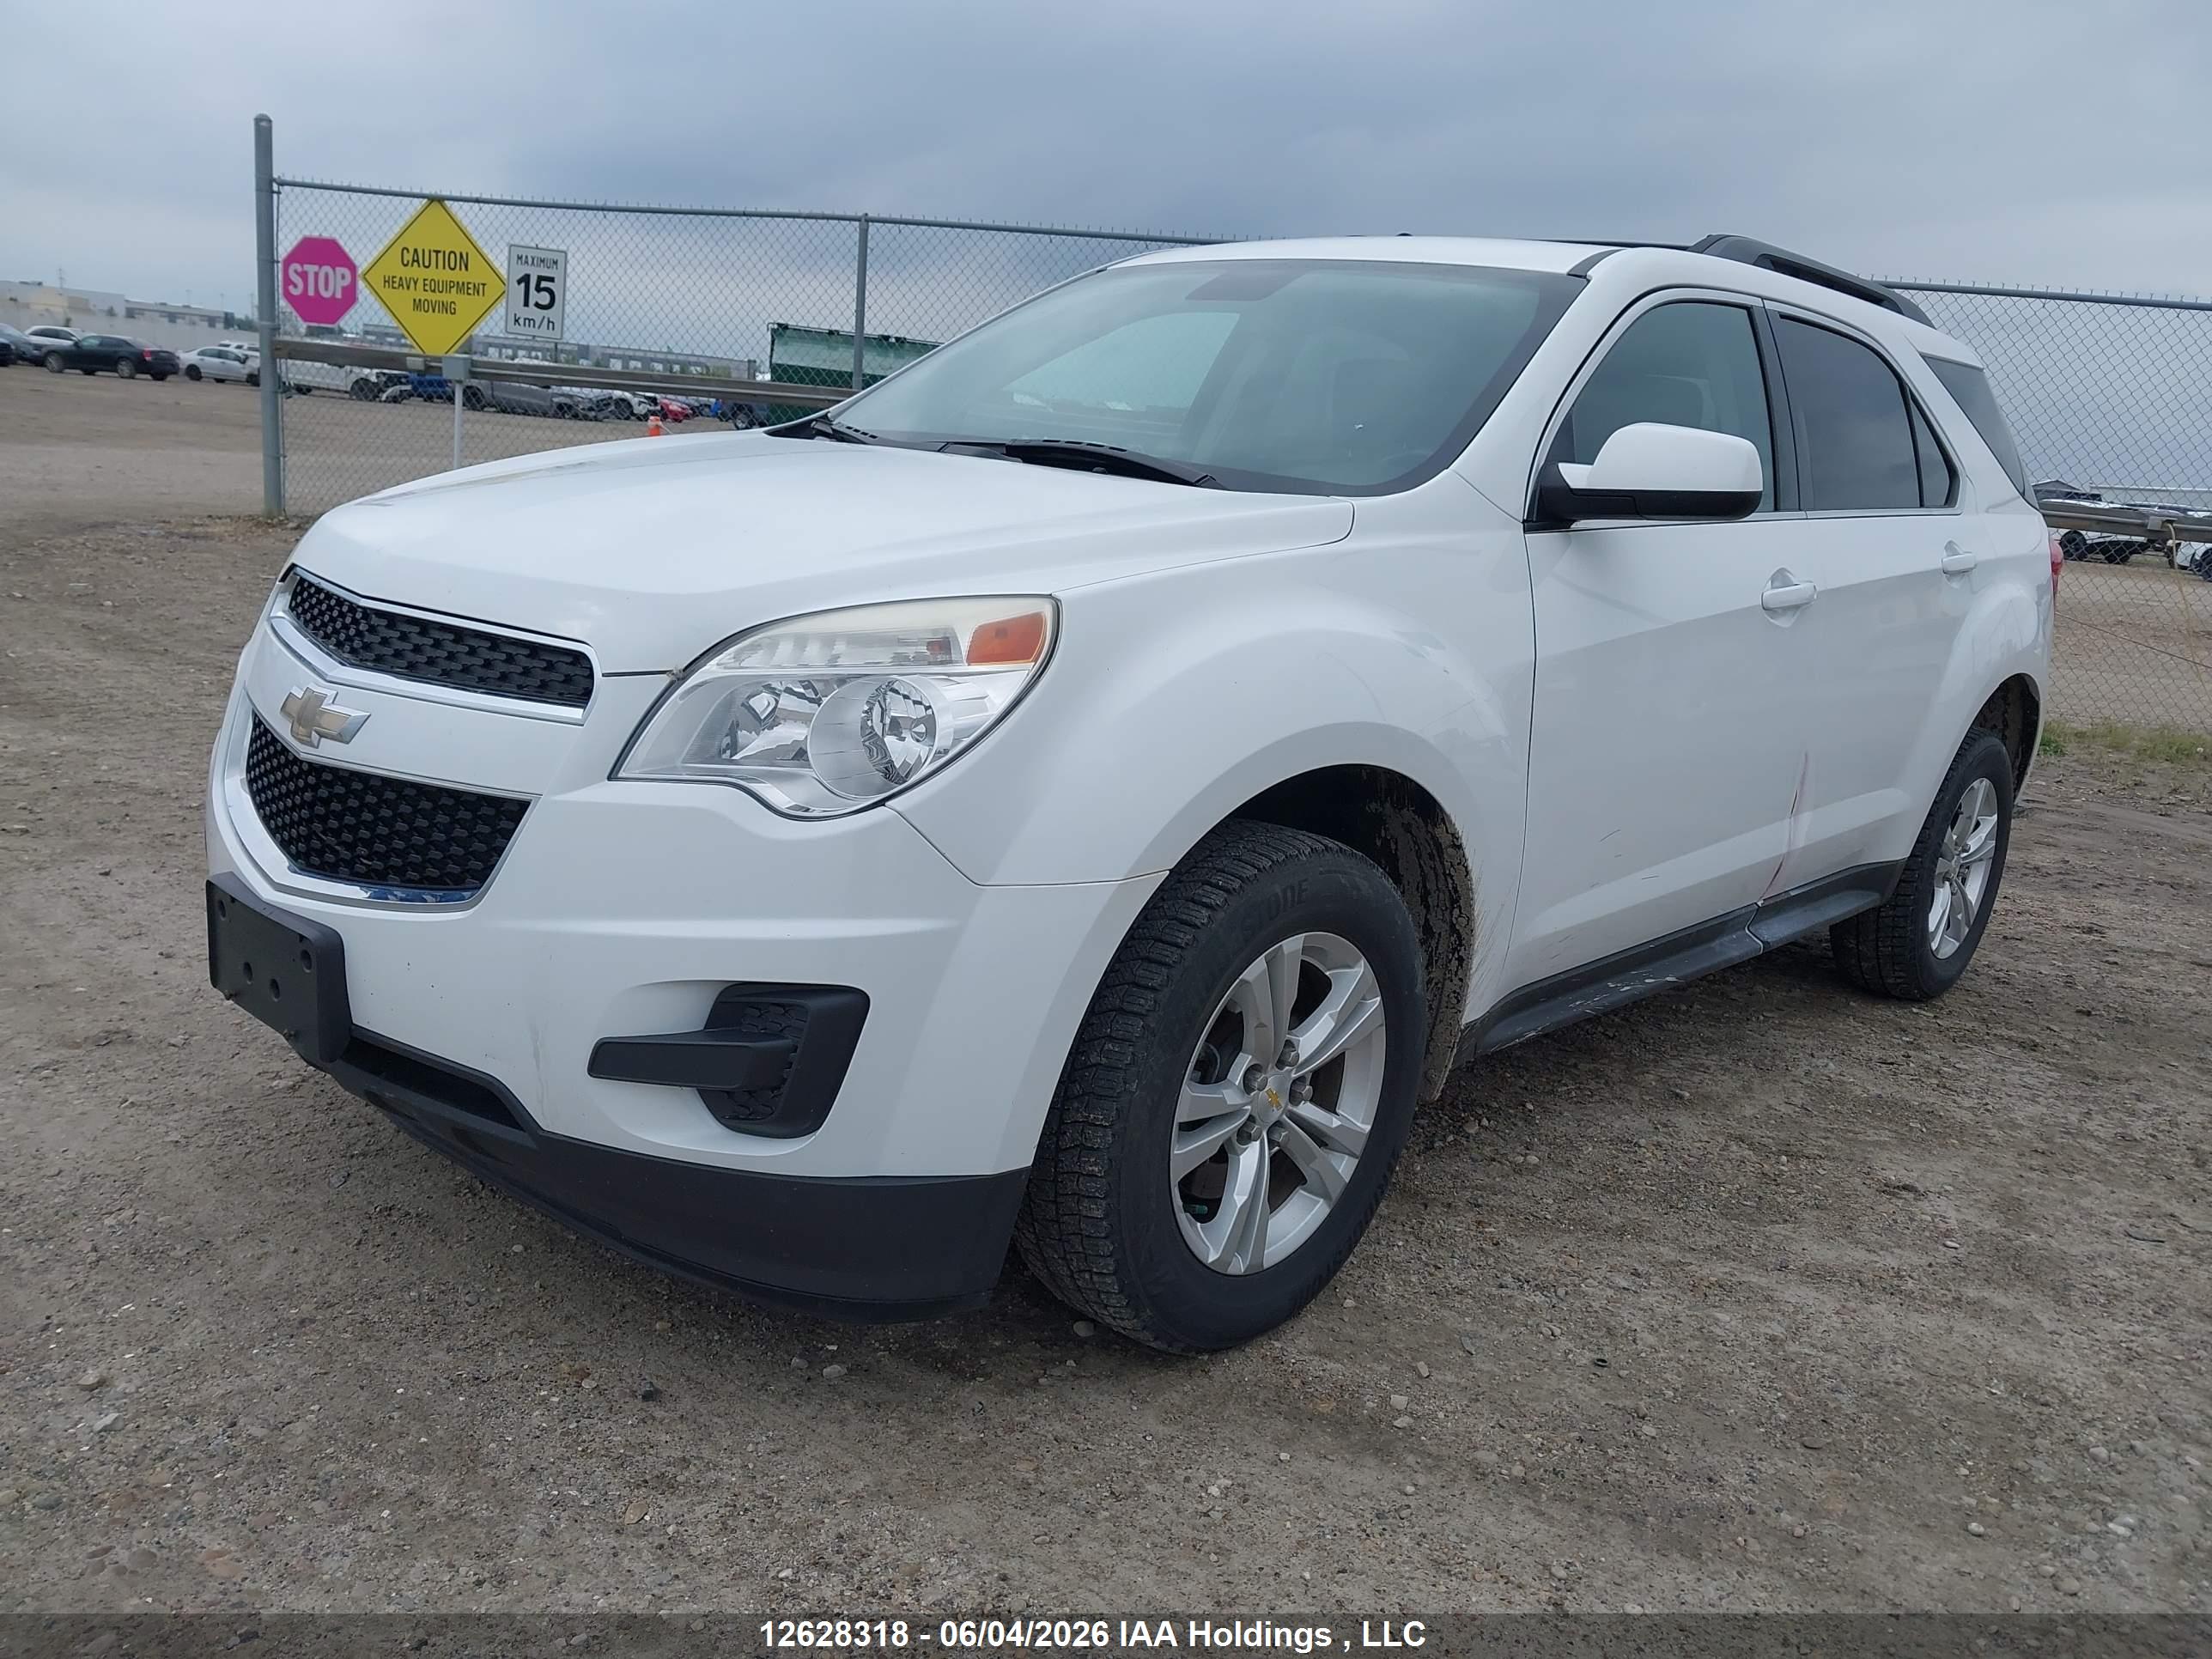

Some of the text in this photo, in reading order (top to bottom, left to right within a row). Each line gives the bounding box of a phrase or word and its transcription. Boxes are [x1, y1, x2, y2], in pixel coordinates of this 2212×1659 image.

[401, 247, 469, 271] CAUTION
[516, 253, 558, 270] MAXIMUM
[288, 263, 352, 299] STOP
[383, 275, 487, 297] HEAVY EQUIPMENT
[516, 273, 556, 310] 15
[412, 298, 457, 315] MOVING
[514, 313, 556, 331] km/h
